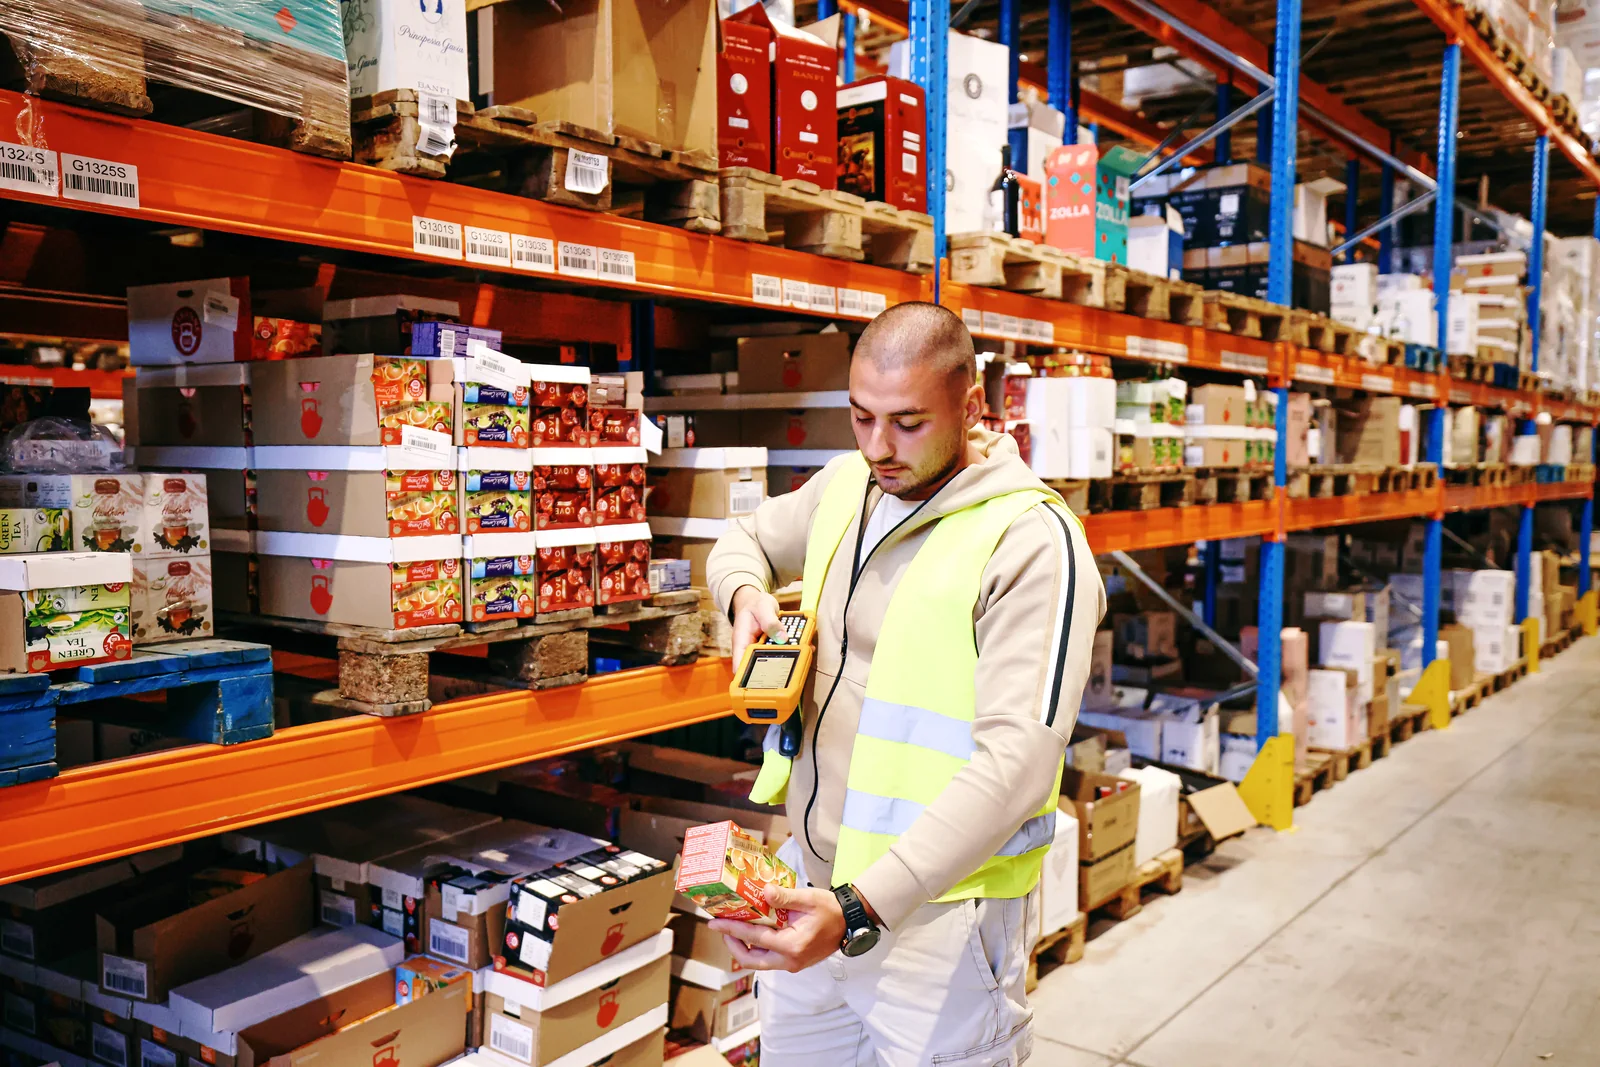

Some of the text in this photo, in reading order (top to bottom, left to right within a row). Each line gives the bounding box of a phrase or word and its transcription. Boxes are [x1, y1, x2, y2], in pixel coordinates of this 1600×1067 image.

[399, 24, 464, 53] Principessa Gavia
[356, 55, 378, 77] Gavia
[72, 159, 127, 178] G1325S
[1049, 204, 1090, 220] ZOLLA
[1096, 201, 1129, 226] ZOLLA
[419, 220, 455, 235] G1301S
[470, 231, 503, 244] G1302S
[516, 238, 547, 251] G1303S
[562, 245, 592, 257] G1304S
[602, 251, 629, 263] G1305S
[605, 425, 624, 433] LOVE
[553, 467, 574, 475] LOVE
[555, 506, 575, 515] LOVE
[0, 513, 9, 550] GREEN
[11, 521, 21, 542] TEA
[67, 637, 87, 648] TEA
[58, 647, 96, 659] GREEN
